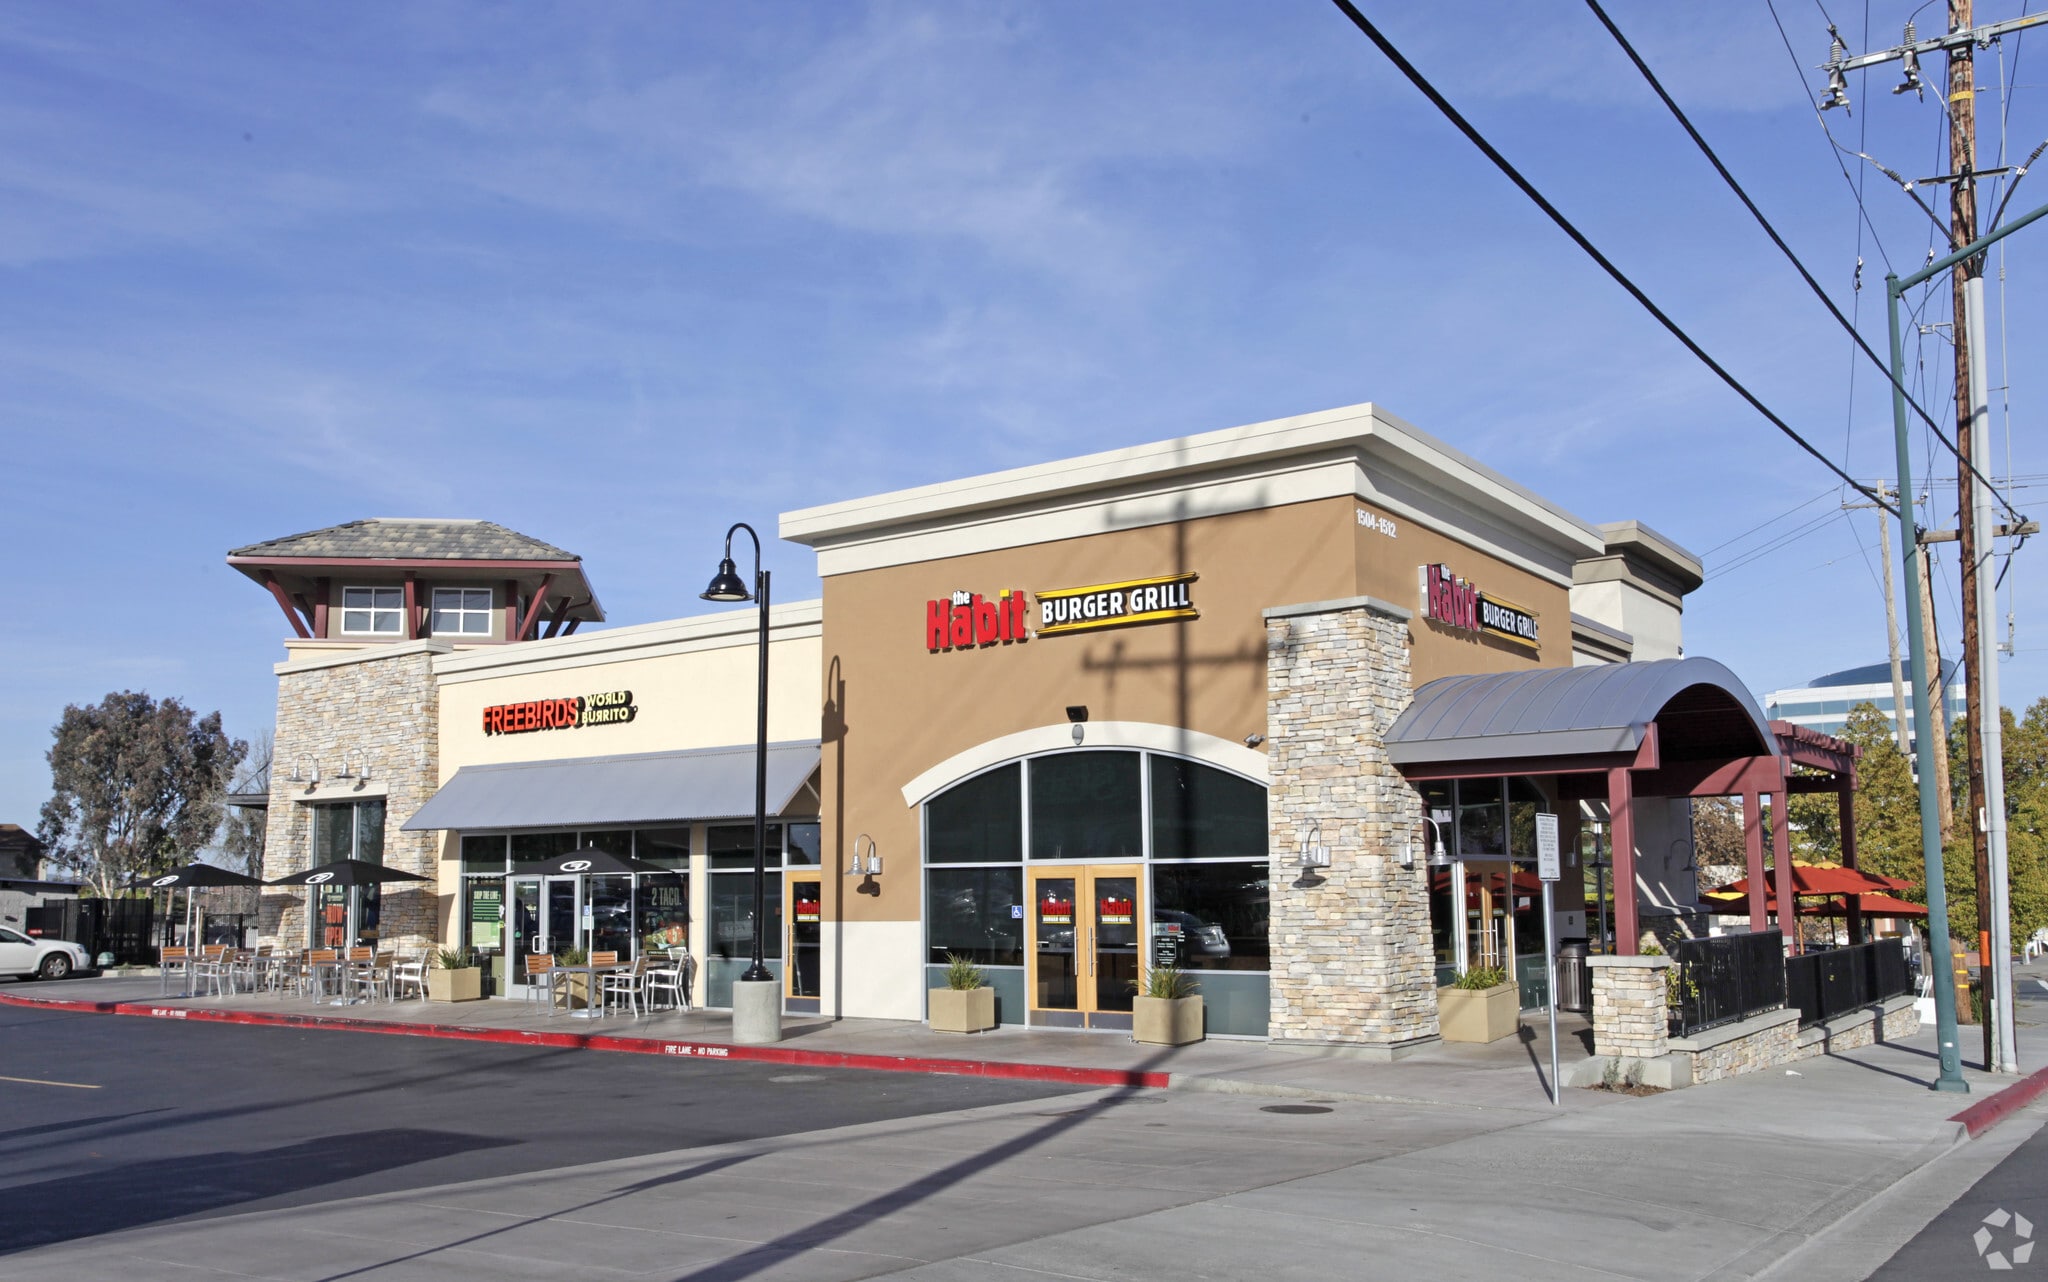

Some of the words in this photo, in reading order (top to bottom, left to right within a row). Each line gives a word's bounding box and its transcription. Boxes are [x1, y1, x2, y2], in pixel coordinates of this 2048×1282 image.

[1356, 508, 1397, 539] 1504-1512
[1441, 563, 1451, 581] the
[953, 590, 970, 605] the
[1042, 591, 1123, 624] BURGER
[1130, 583, 1189, 612] GRILL
[1427, 564, 1479, 631] Habit
[927, 589, 1026, 649] Habit
[1483, 601, 1516, 633] BURGER
[1517, 615, 1539, 640] GRILL
[587, 691, 626, 707] WORLD
[482, 697, 578, 732] FREEB!RDS
[582, 708, 629, 724] BURRITO
[1041, 899, 1072, 915] Habit
[1101, 899, 1132, 915] Habit
[665, 1045, 677, 1055] FIRE
[678, 1045, 692, 1055] LANE
[698, 1046, 706, 1055] NO
[707, 1047, 728, 1057] PARKING
